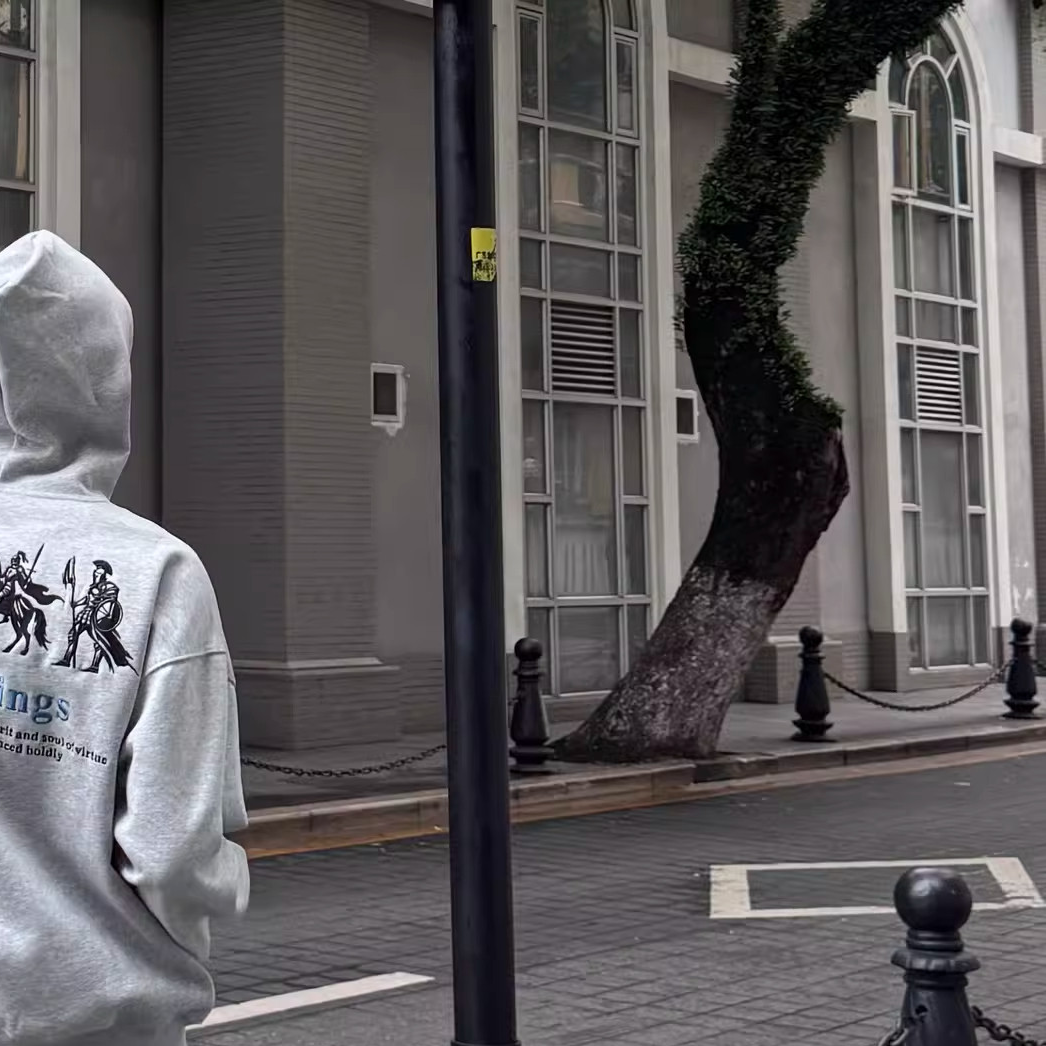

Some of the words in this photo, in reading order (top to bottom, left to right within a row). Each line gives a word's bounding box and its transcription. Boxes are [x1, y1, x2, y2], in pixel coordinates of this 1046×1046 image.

[15, 731, 39, 742] and
[41, 734, 65, 747] soul
[75, 746, 108, 764] virtue
[26, 744, 64, 762] boldly
